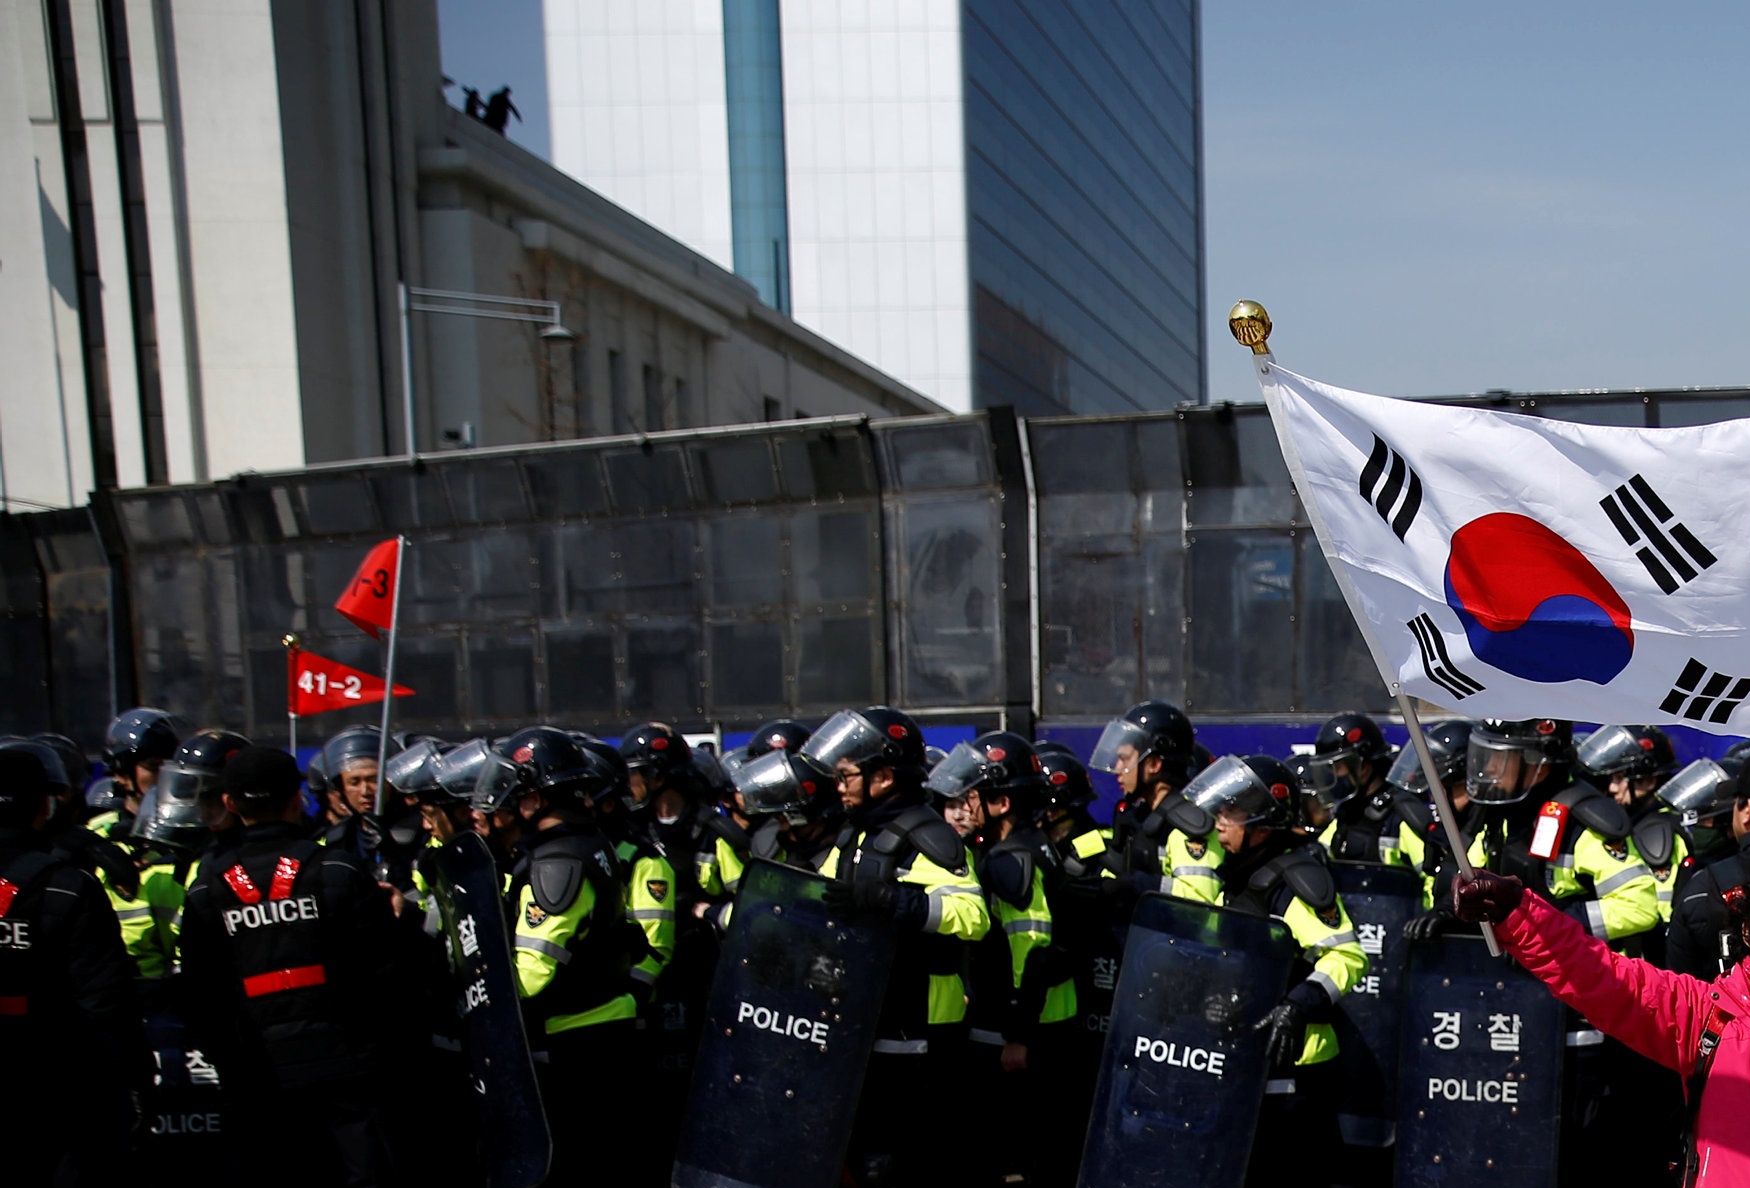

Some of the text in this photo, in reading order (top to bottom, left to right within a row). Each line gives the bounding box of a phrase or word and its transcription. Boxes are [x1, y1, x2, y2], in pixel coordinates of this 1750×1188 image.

[297, 670, 362, 700] 41-2
[228, 898, 315, 932] POLICE
[737, 1001, 830, 1045] POLICE
[1134, 1036, 1226, 1075] POLICE
[1428, 1078, 1519, 1103] POLICE
